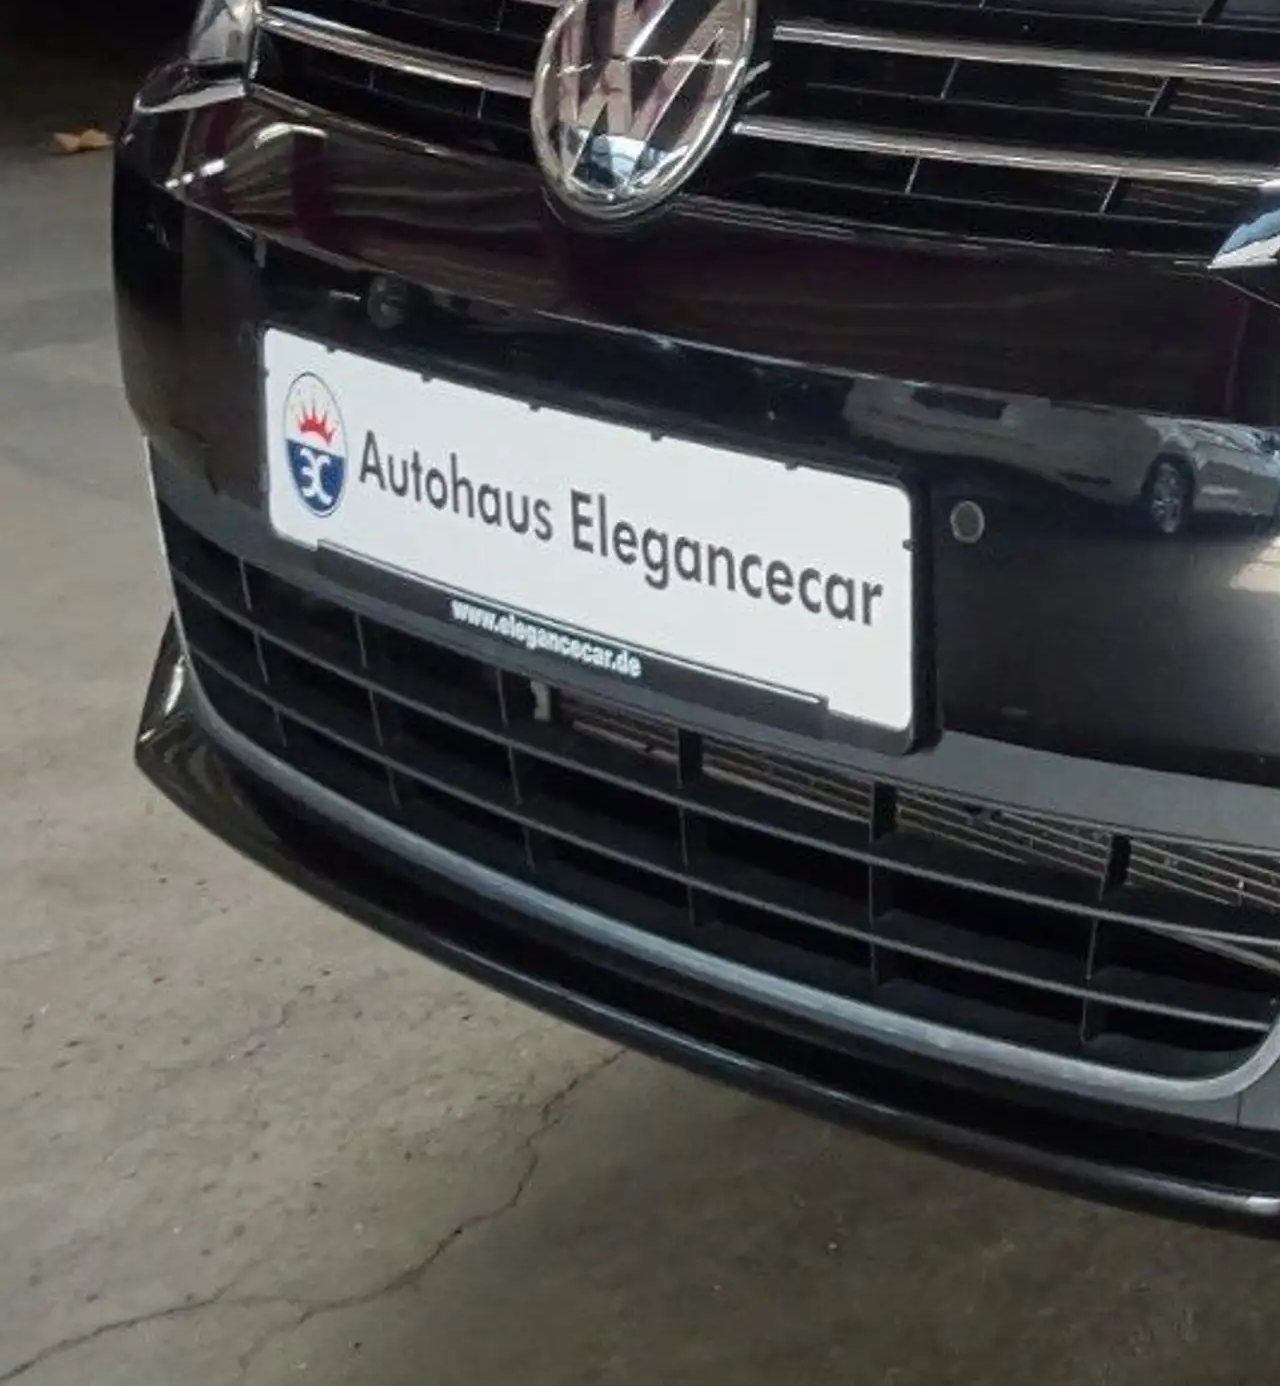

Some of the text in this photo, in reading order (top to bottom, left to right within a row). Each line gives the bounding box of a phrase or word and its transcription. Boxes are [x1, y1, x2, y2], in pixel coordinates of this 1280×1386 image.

[359, 430, 882, 626] Autohaus Elegancecar
[451, 598, 642, 678] www.elegancecar.de
